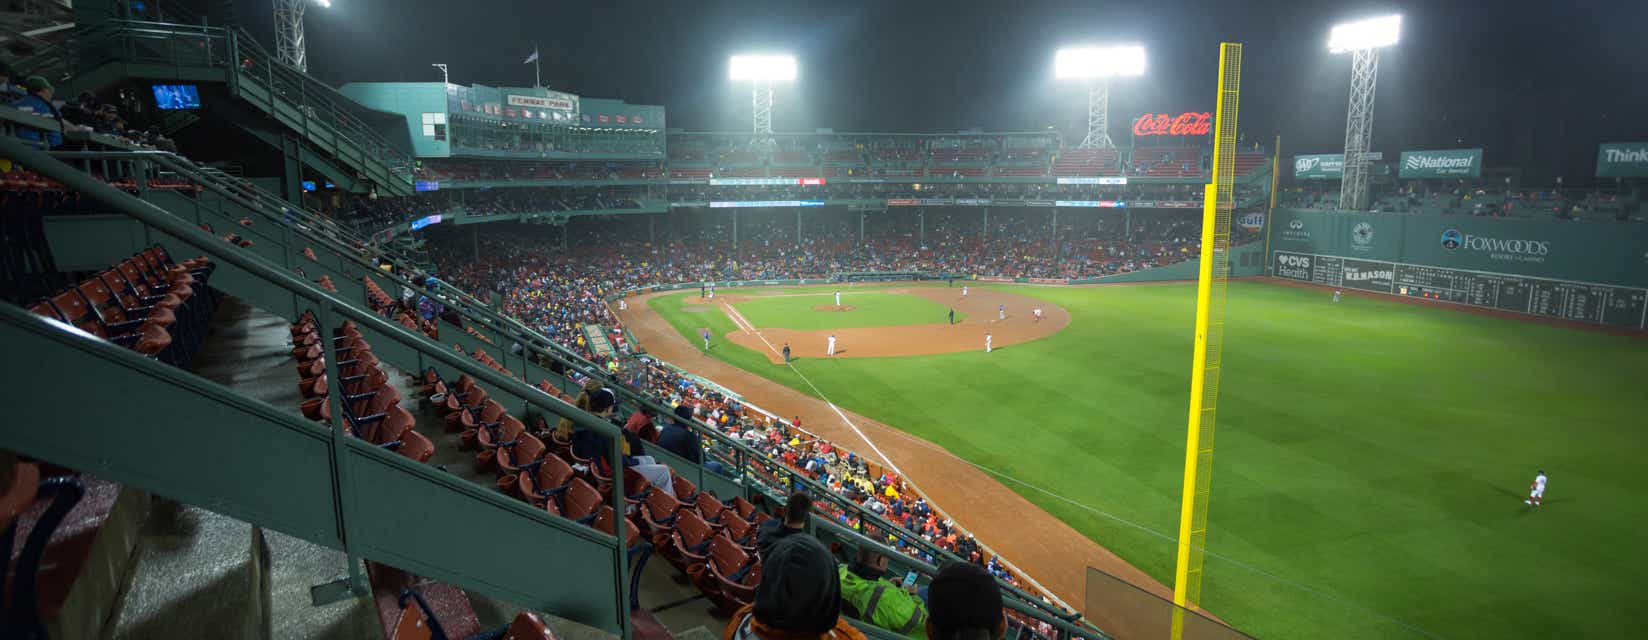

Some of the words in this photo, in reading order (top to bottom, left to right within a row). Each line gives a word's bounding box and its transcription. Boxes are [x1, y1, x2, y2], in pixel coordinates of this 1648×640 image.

[1134, 112, 1211, 135] Coca-Cola
[1419, 155, 1474, 168] National
[1605, 148, 1648, 162] Think
[1239, 215, 1264, 226] Gulf
[1288, 255, 1310, 268] CVS
[1279, 265, 1309, 280] Health
